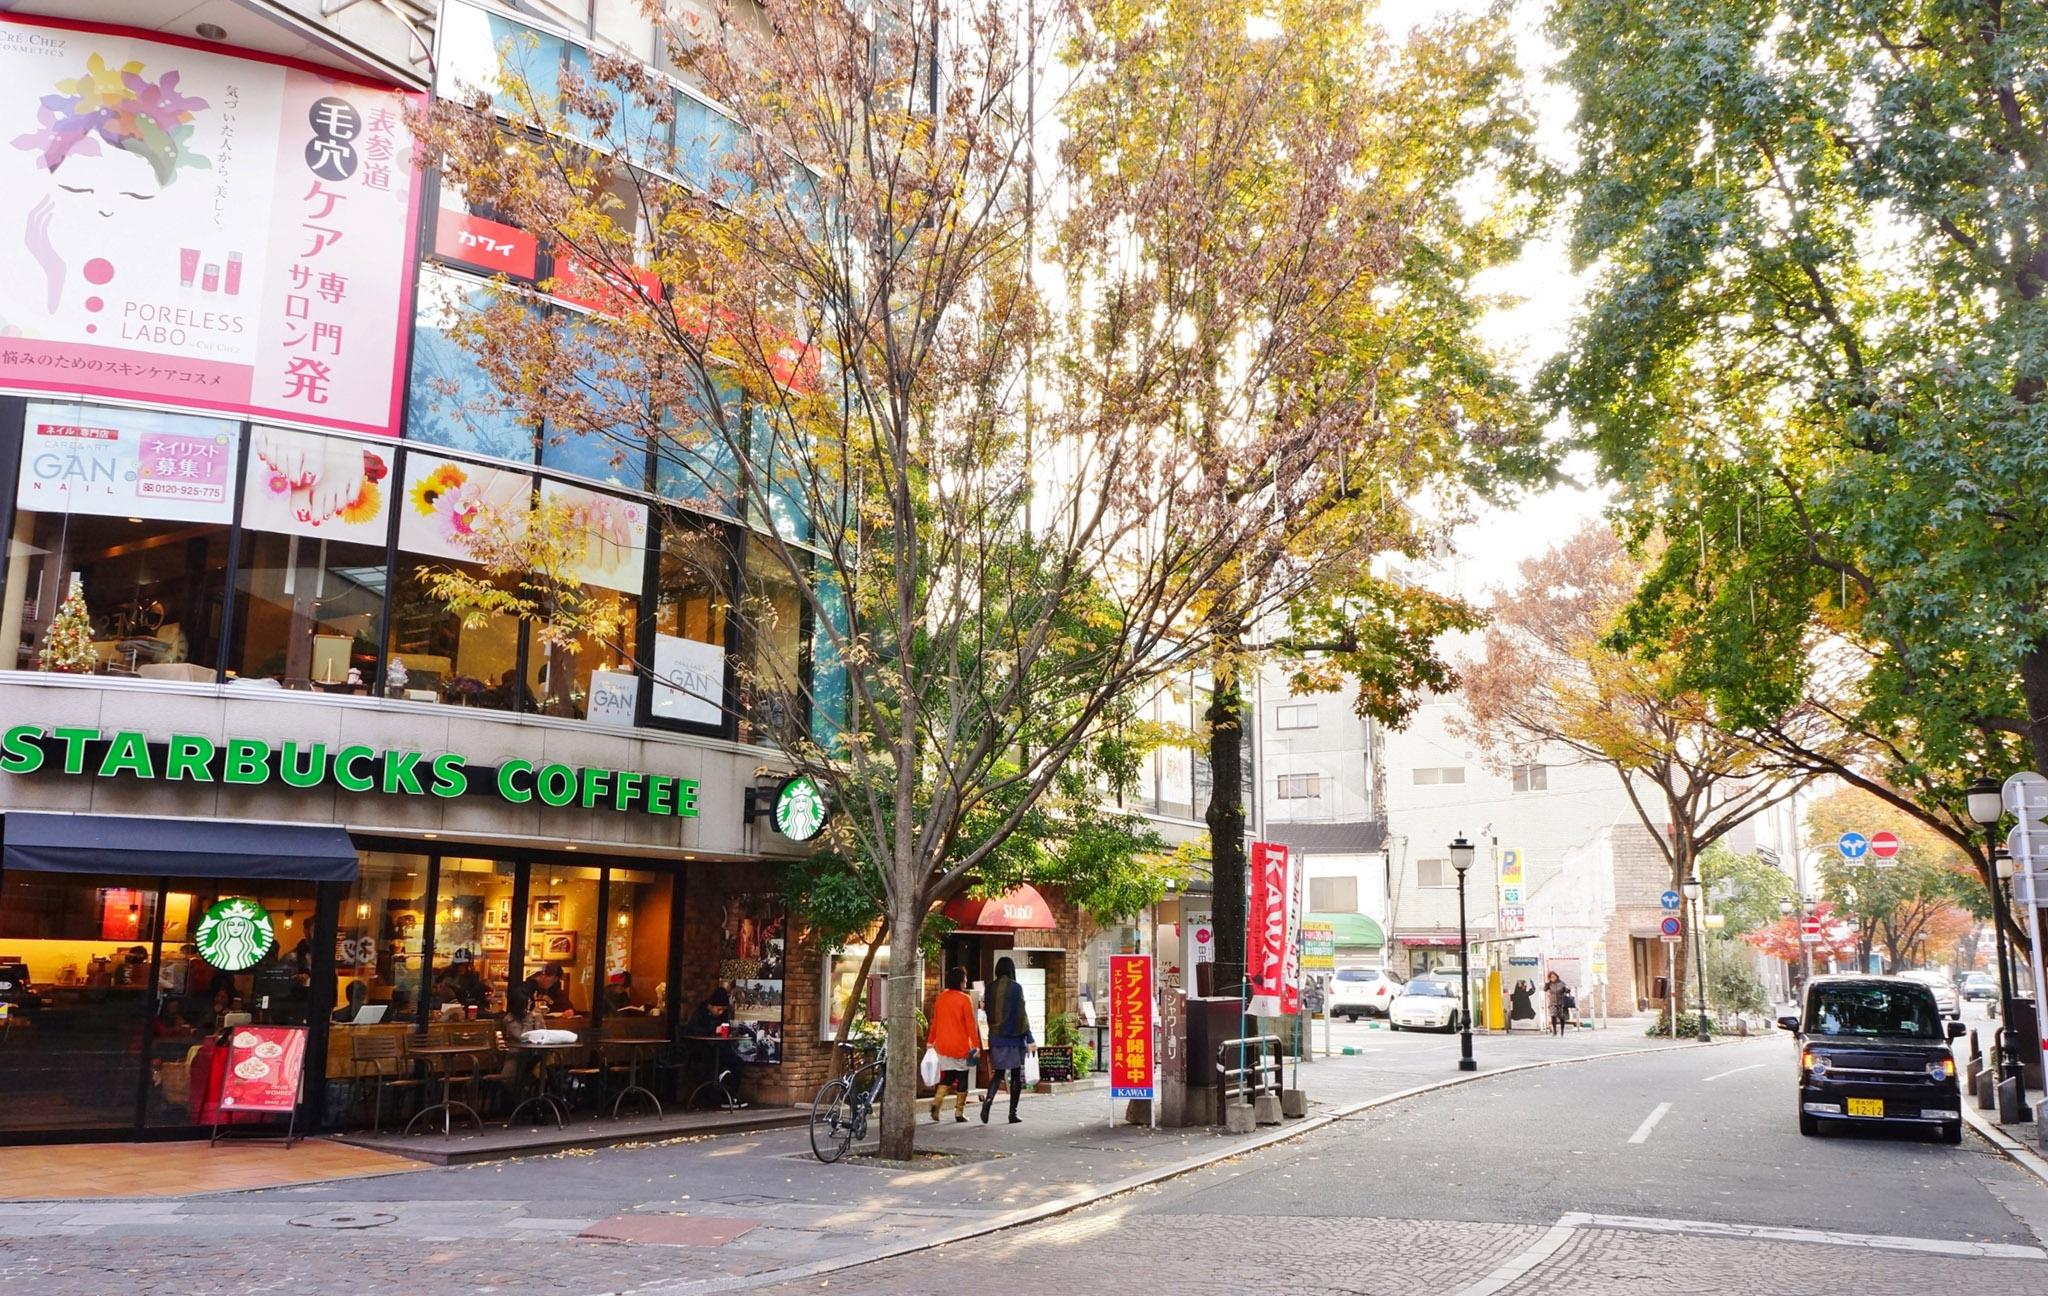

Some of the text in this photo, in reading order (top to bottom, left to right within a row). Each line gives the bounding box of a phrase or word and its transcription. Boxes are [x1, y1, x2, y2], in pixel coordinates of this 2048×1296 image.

[29, 34, 66, 48] CHEZ
[362, 108, 396, 192] 表参道
[457, 230, 515, 257] カワイ
[124, 301, 244, 333] PORELESS
[121, 322, 186, 346] LABO
[46, 426, 110, 439] ネイル 専門店
[151, 440, 220, 459] ネイリスト
[33, 482, 115, 494] NAIL
[155, 484, 220, 497] 0120-925-775
[0, 725, 701, 818] STARBUCKS COFFEE
[1261, 848, 1285, 991] KAWAI
[1126, 960, 1145, 1084] ピアノフェア開催中
[1167, 994, 1177, 1060] シャワー通り
[1117, 1088, 1147, 1097] KAWAI
[1855, 1105, 1882, 1115] 12-12
